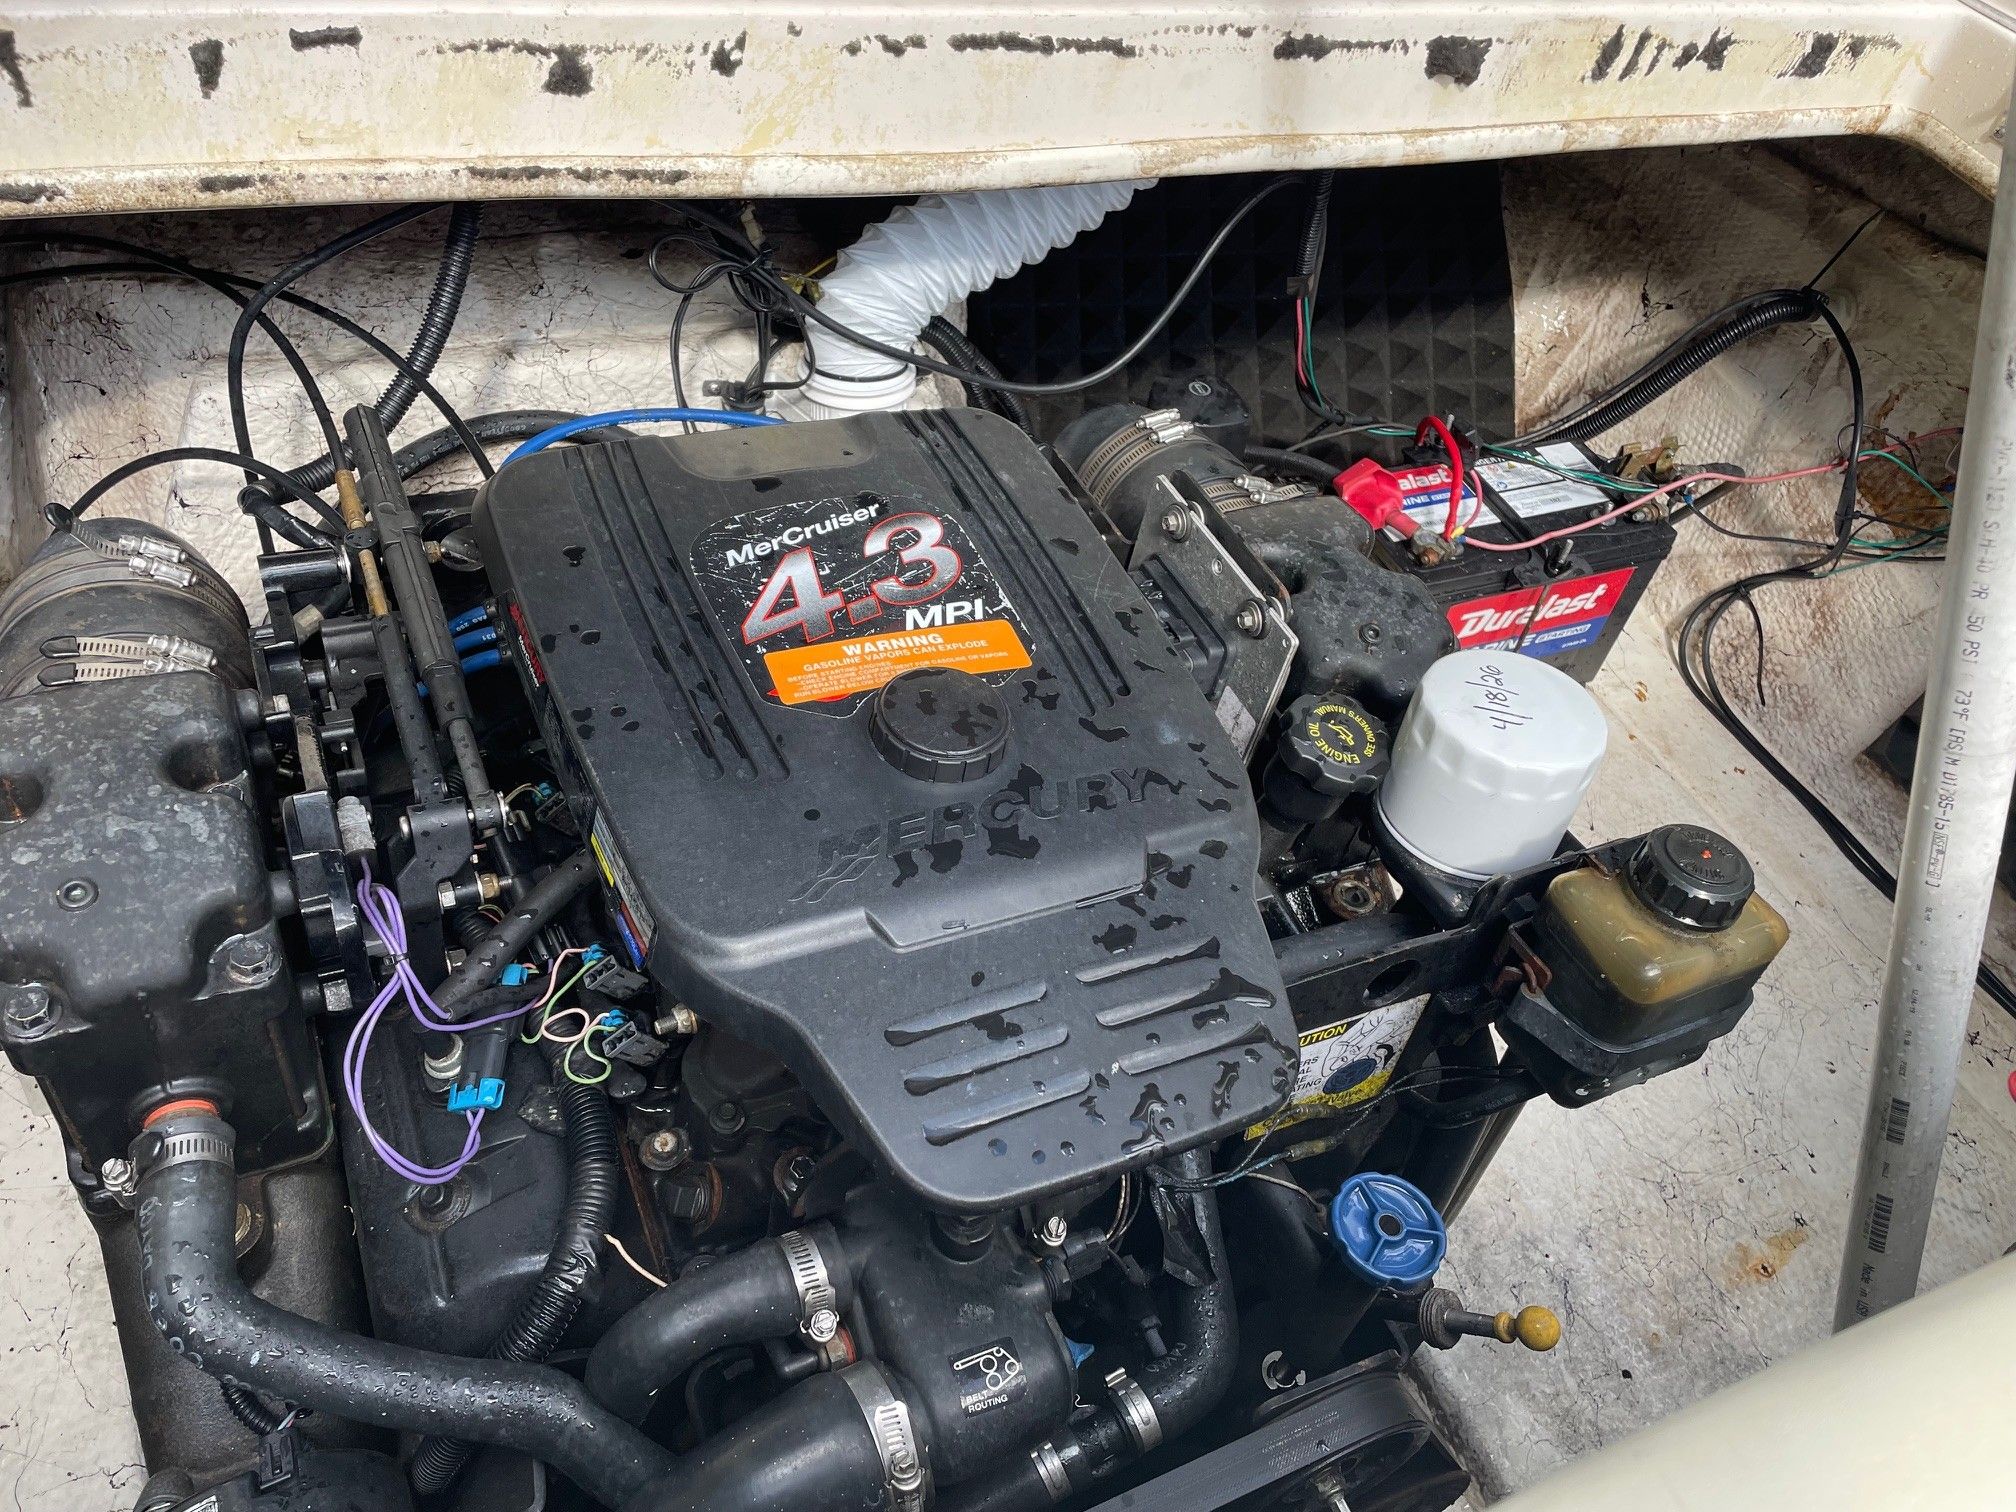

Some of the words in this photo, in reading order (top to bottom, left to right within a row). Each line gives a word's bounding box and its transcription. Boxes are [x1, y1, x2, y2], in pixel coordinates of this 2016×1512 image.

[1398, 469, 1452, 490] alast
[726, 502, 879, 568] MerCruiser
[741, 512, 963, 644] 4.3
[905, 599, 985, 631] MPI
[1457, 583, 1608, 639] Duralast
[803, 655, 861, 672] GASOLINE
[863, 648, 911, 661] VAPORS
[913, 643, 937, 654] CAN
[939, 640, 989, 652] EXPLODE
[841, 633, 944, 656] WARNING
[1962, 640, 1980, 664] PSI
[932, 656, 966, 665] GASOLINE
[980, 651, 1008, 659] VAPORS
[787, 672, 818, 683] BEFORE
[820, 666, 858, 677] STARTING
[1465, 665, 1533, 730] 4/18/26
[1952, 690, 1973, 721] 73°F
[1313, 704, 1347, 716] MANUAL
[1308, 722, 1321, 737] OIL
[1348, 710, 1376, 743] OWNER'S
[1315, 738, 1361, 765] ENGINE
[1364, 742, 1376, 758] SEE
[815, 767, 1150, 880] MERCURY
[1299, 1023, 1347, 1047] UTION
[1861, 1263, 1876, 1285] Made
[1860, 1287, 1867, 1298] in
[1856, 1301, 1870, 1317] USA
[965, 1390, 988, 1405] BELT
[968, 1394, 1008, 1413] ROUTING
